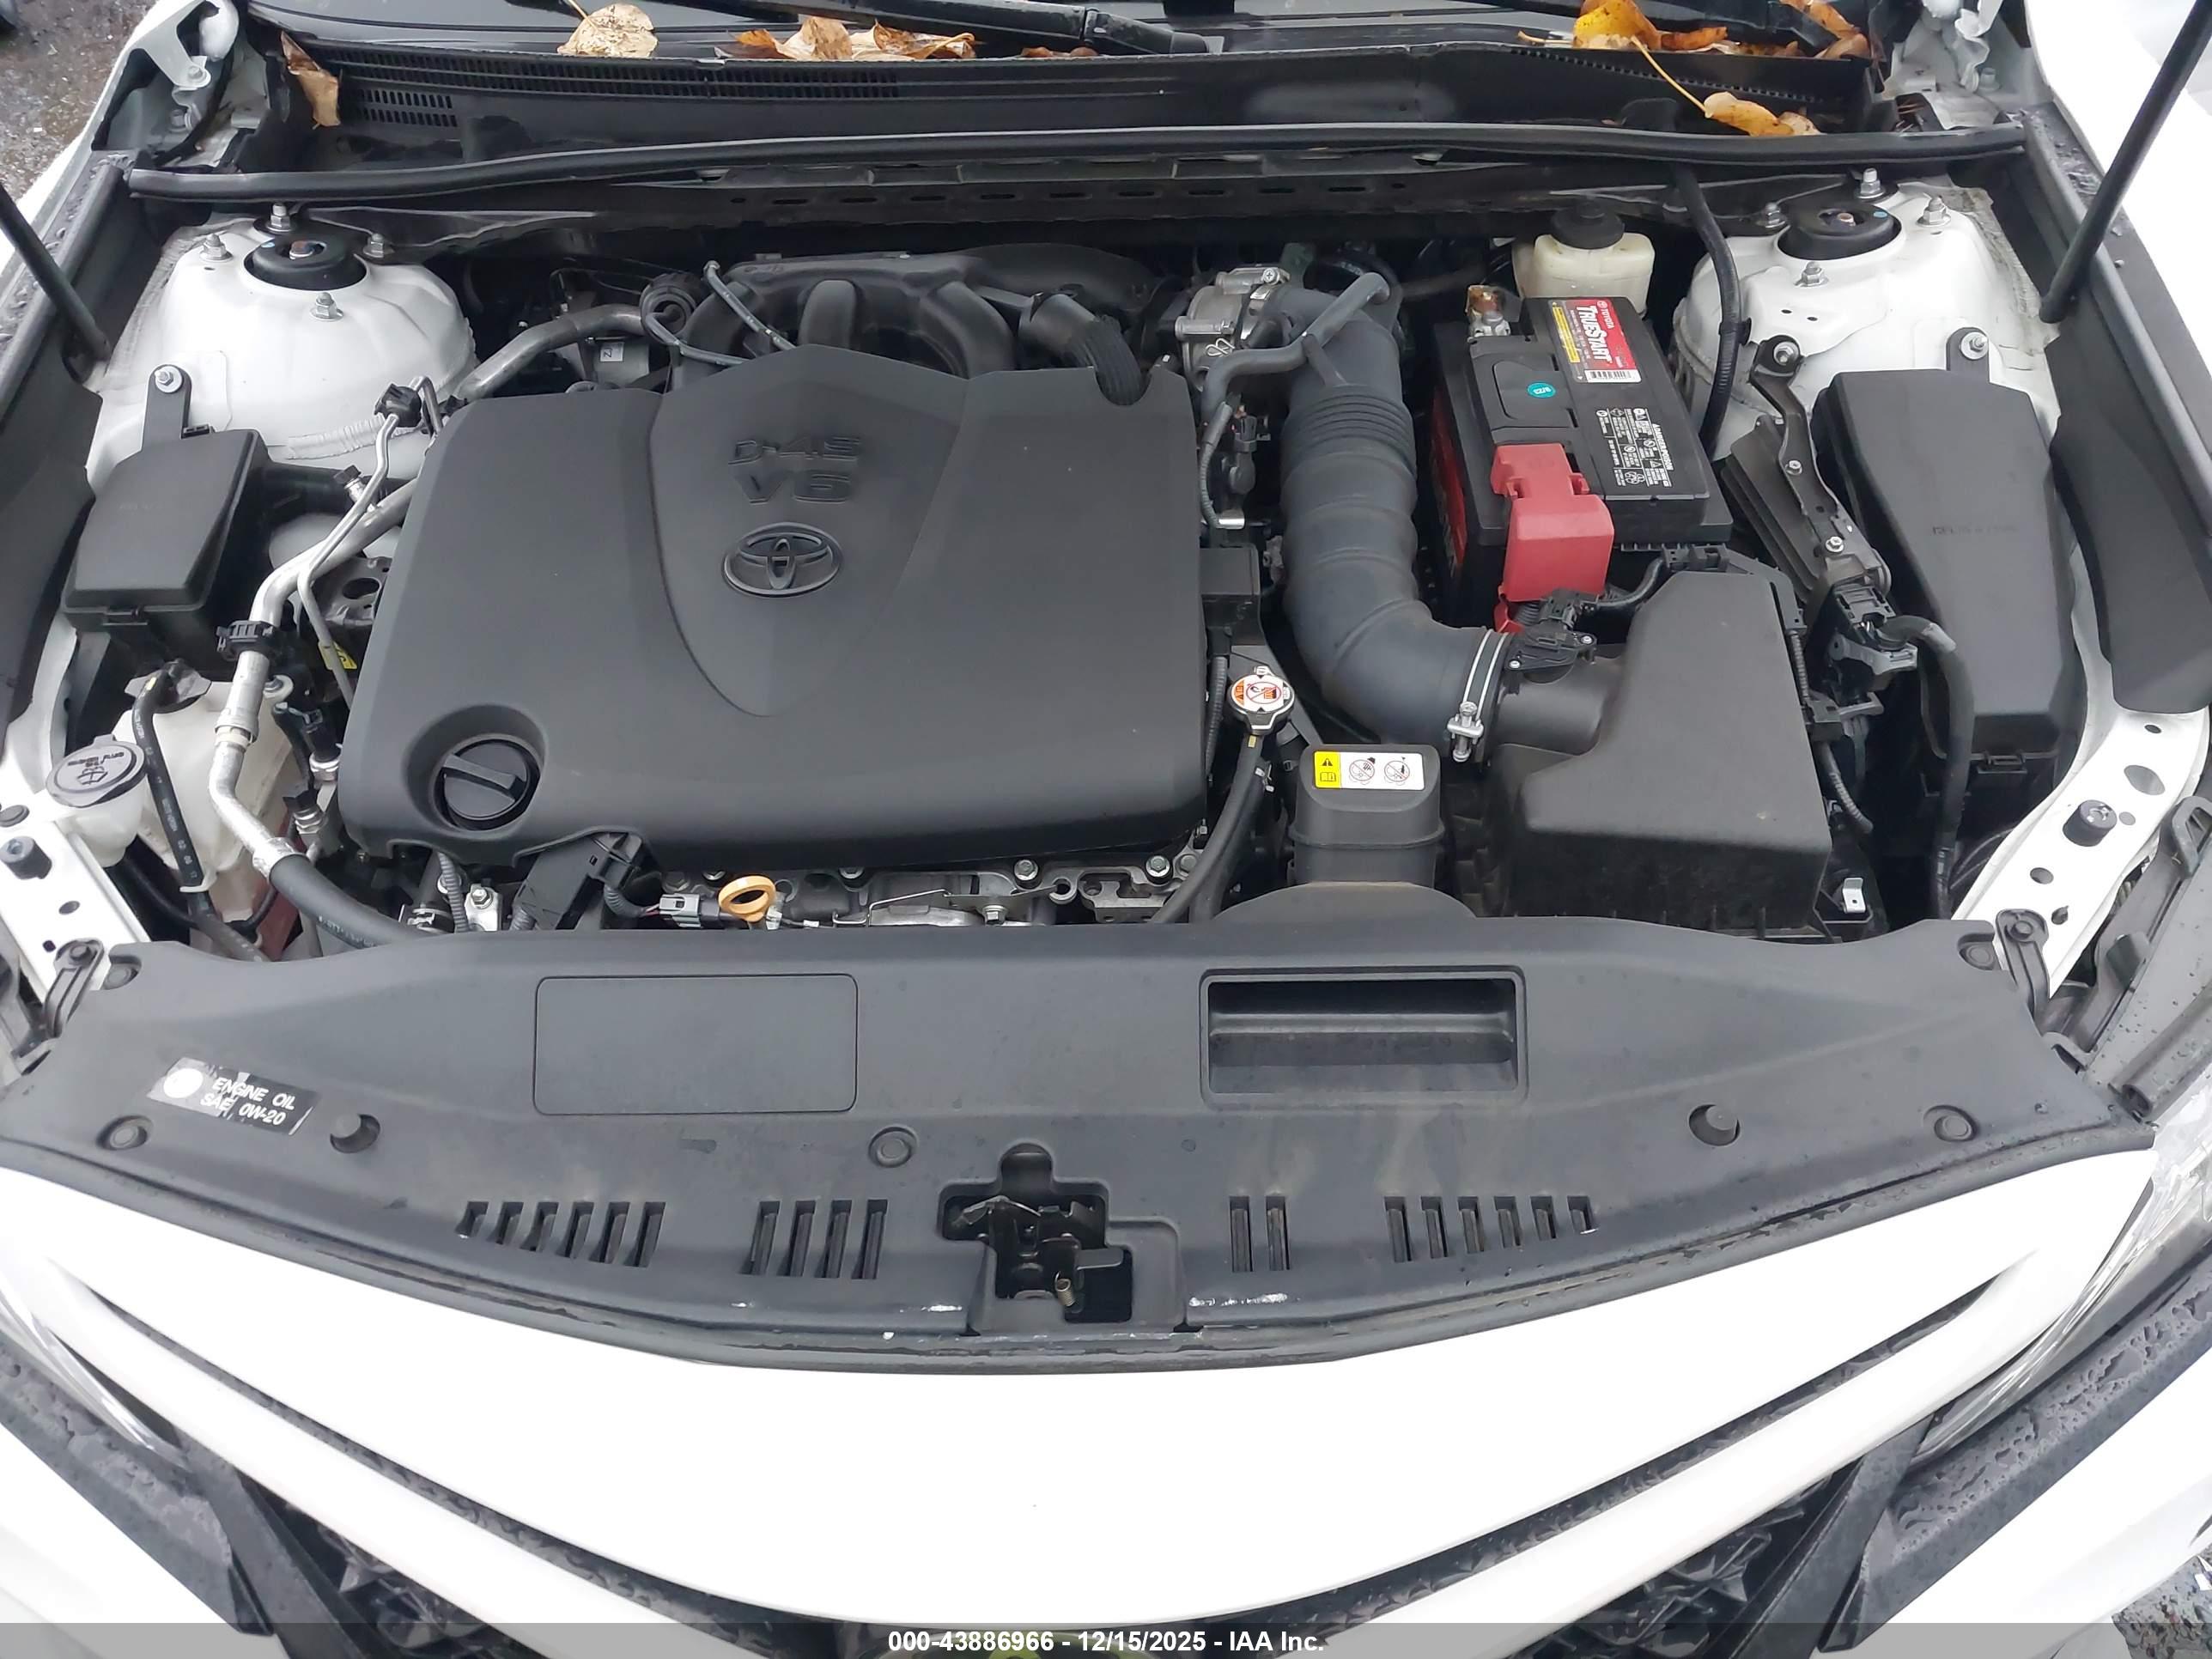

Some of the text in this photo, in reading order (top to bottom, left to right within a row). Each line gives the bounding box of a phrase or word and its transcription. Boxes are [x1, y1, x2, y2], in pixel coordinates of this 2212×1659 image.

[1601, 309, 1614, 329] TOYOTA
[733, 470, 852, 506] V6
[200, 1092, 286, 1125] SAE 0W-20
[212, 1077, 295, 1110] ENGINE OIL
